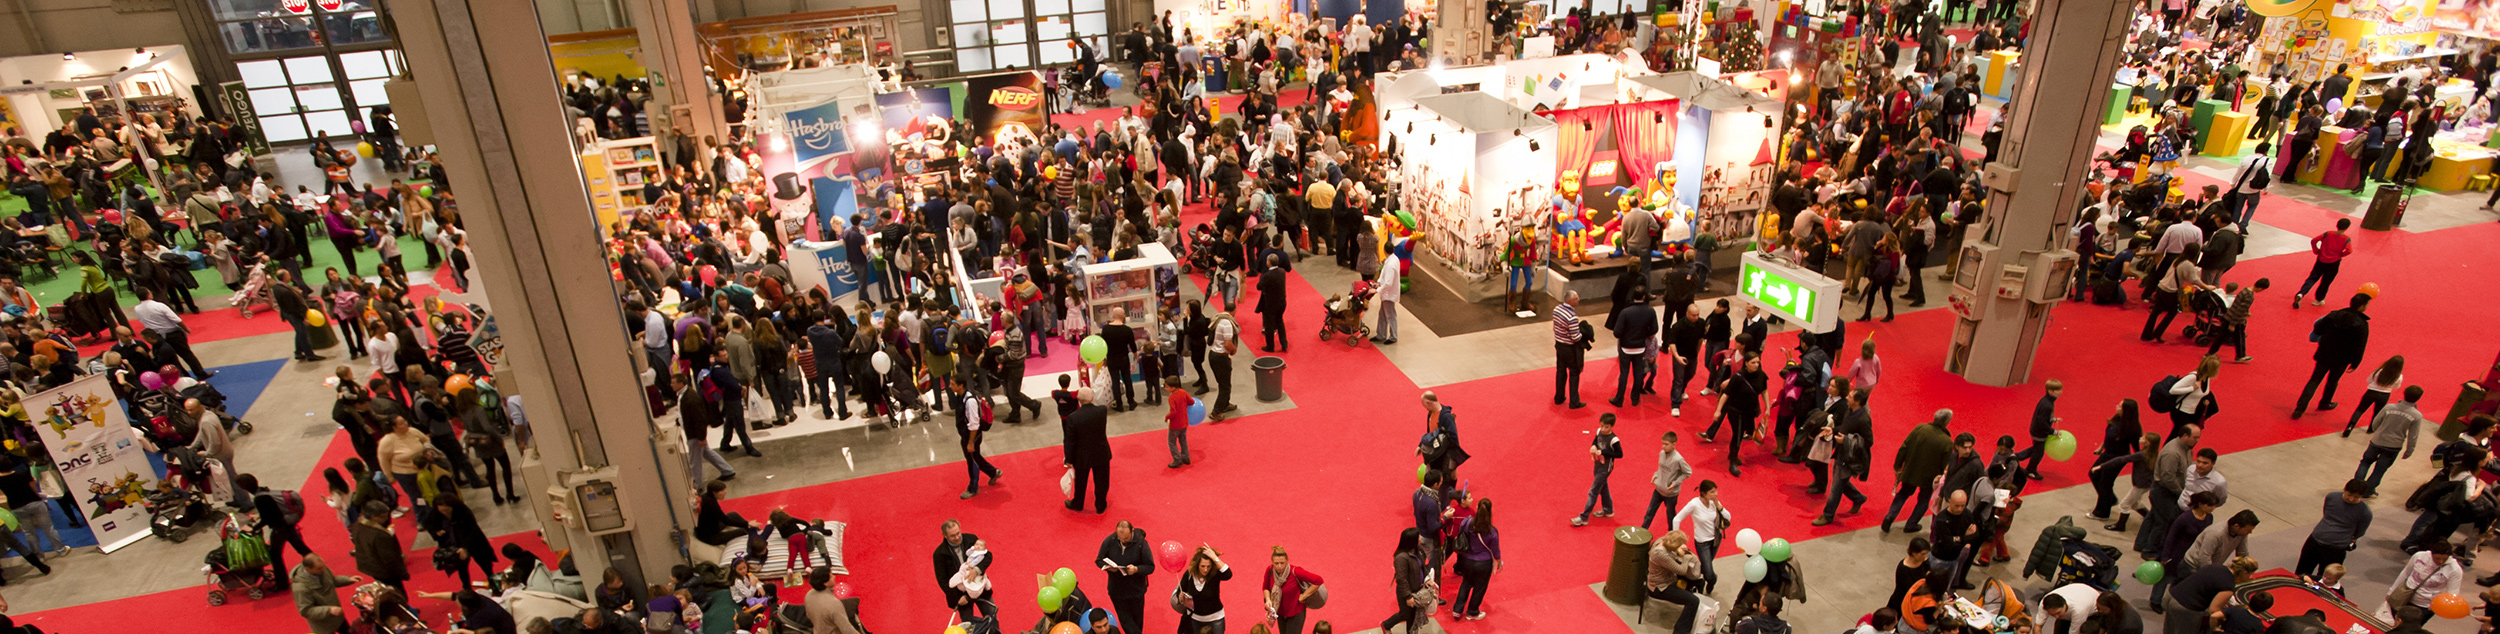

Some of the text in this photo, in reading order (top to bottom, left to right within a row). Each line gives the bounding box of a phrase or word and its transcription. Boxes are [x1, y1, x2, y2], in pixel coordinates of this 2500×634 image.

[285, 0, 307, 8] STOP
[988, 89, 1038, 105] NERF
[784, 117, 844, 137] Hasbro
[1589, 160, 1617, 177] LEGO
[818, 256, 852, 275] Has
